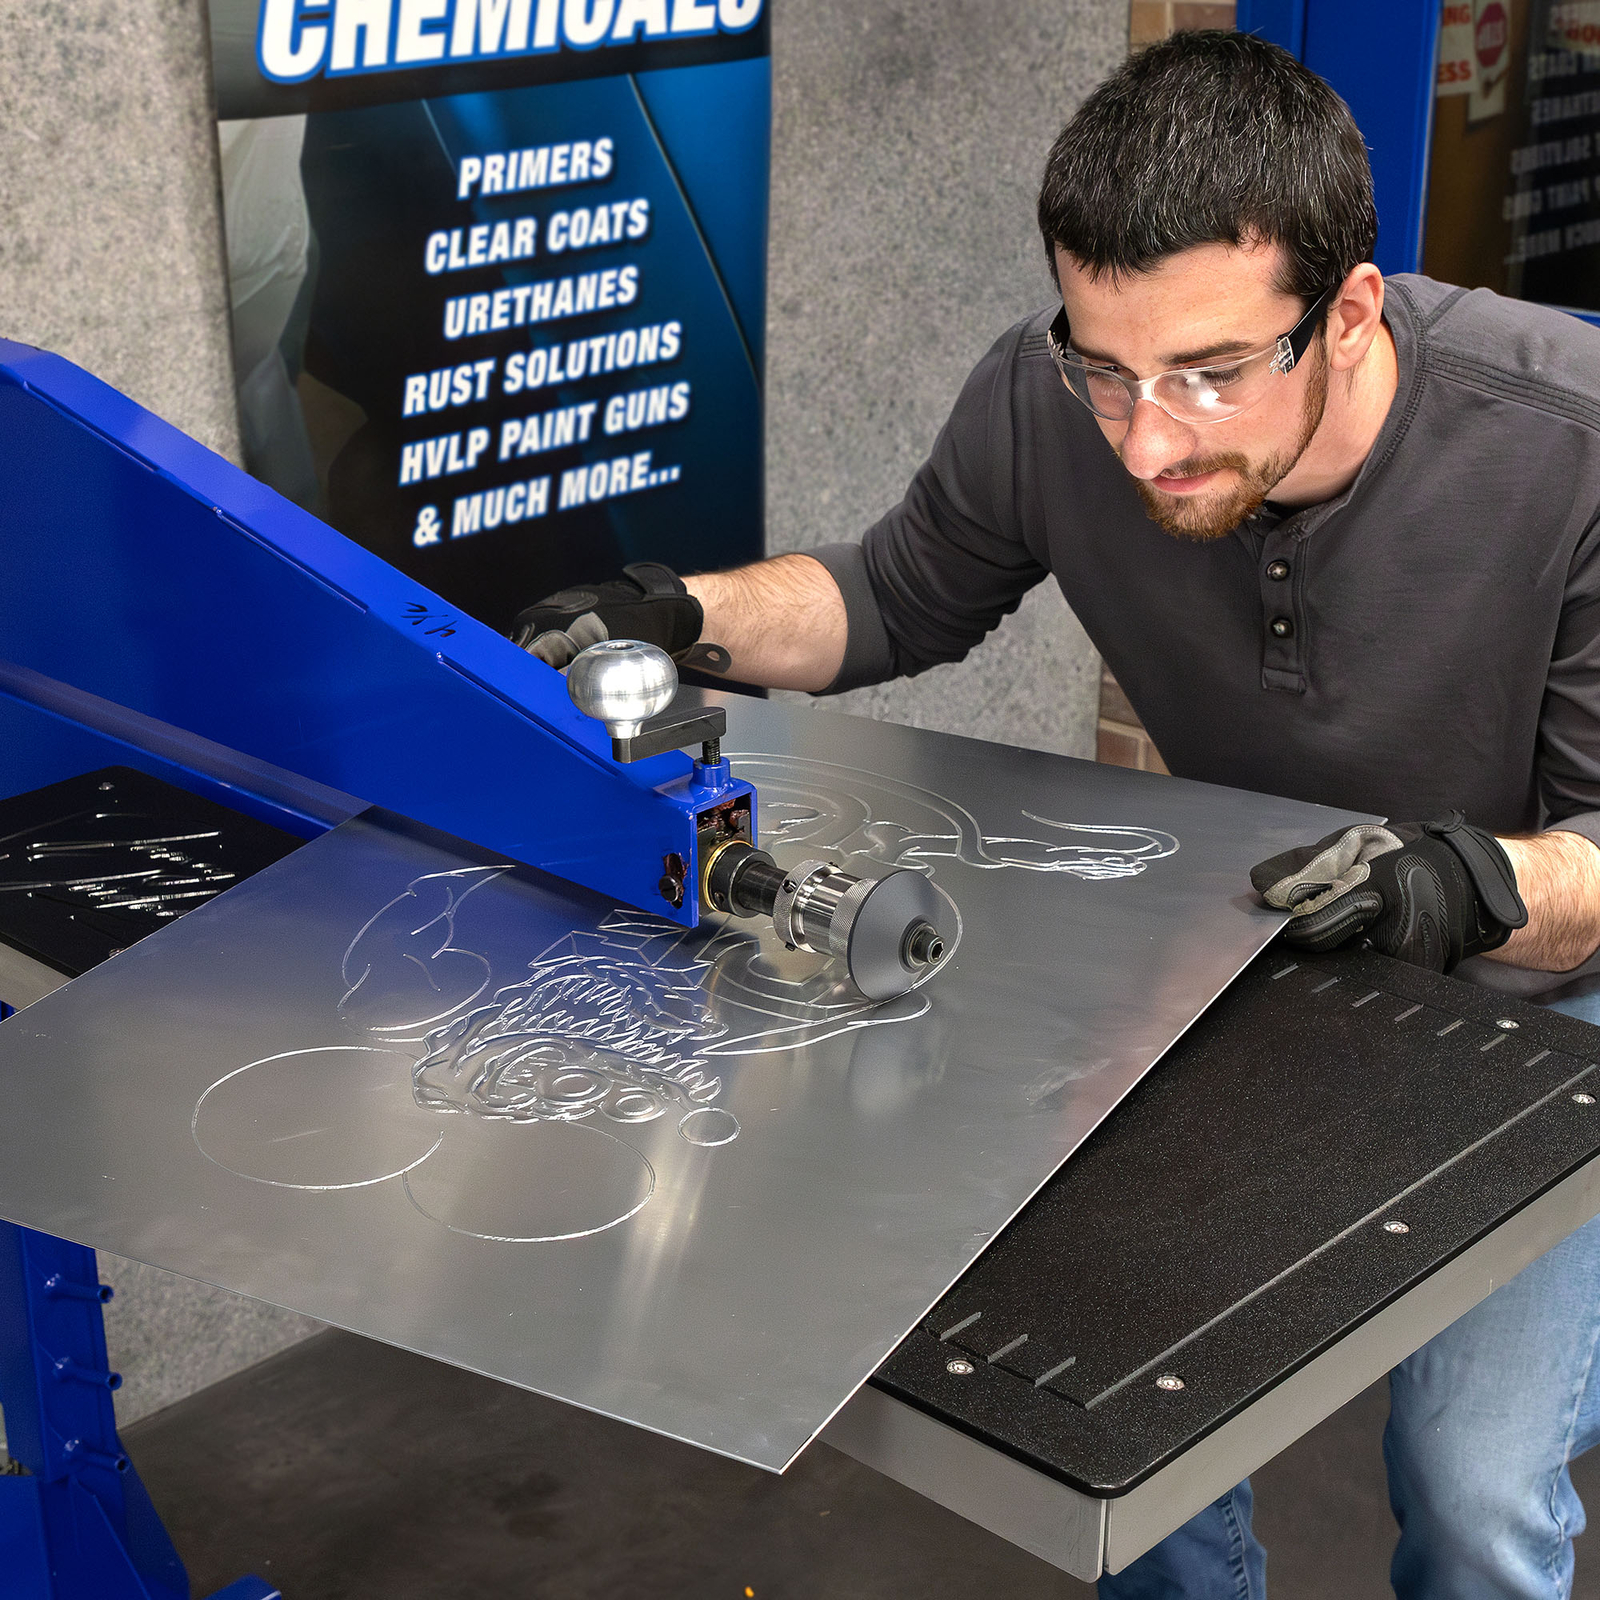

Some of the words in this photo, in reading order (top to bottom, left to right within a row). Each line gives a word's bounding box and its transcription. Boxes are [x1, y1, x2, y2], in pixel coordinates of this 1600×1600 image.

[257, 0, 764, 81] CHEMI
[458, 137, 613, 198] PRIMERS
[425, 218, 537, 273] CLEAR
[547, 198, 649, 252] COATS
[444, 265, 638, 339] URETHANES
[403, 359, 495, 416] RUST
[503, 321, 681, 393] SOLUTIONS
[400, 428, 489, 484] HVLP
[499, 402, 596, 460] PAINT
[604, 382, 690, 434] GUNS
[413, 506, 441, 546] &
[452, 477, 550, 537] MUCH
[559, 452, 680, 509] MORE...
